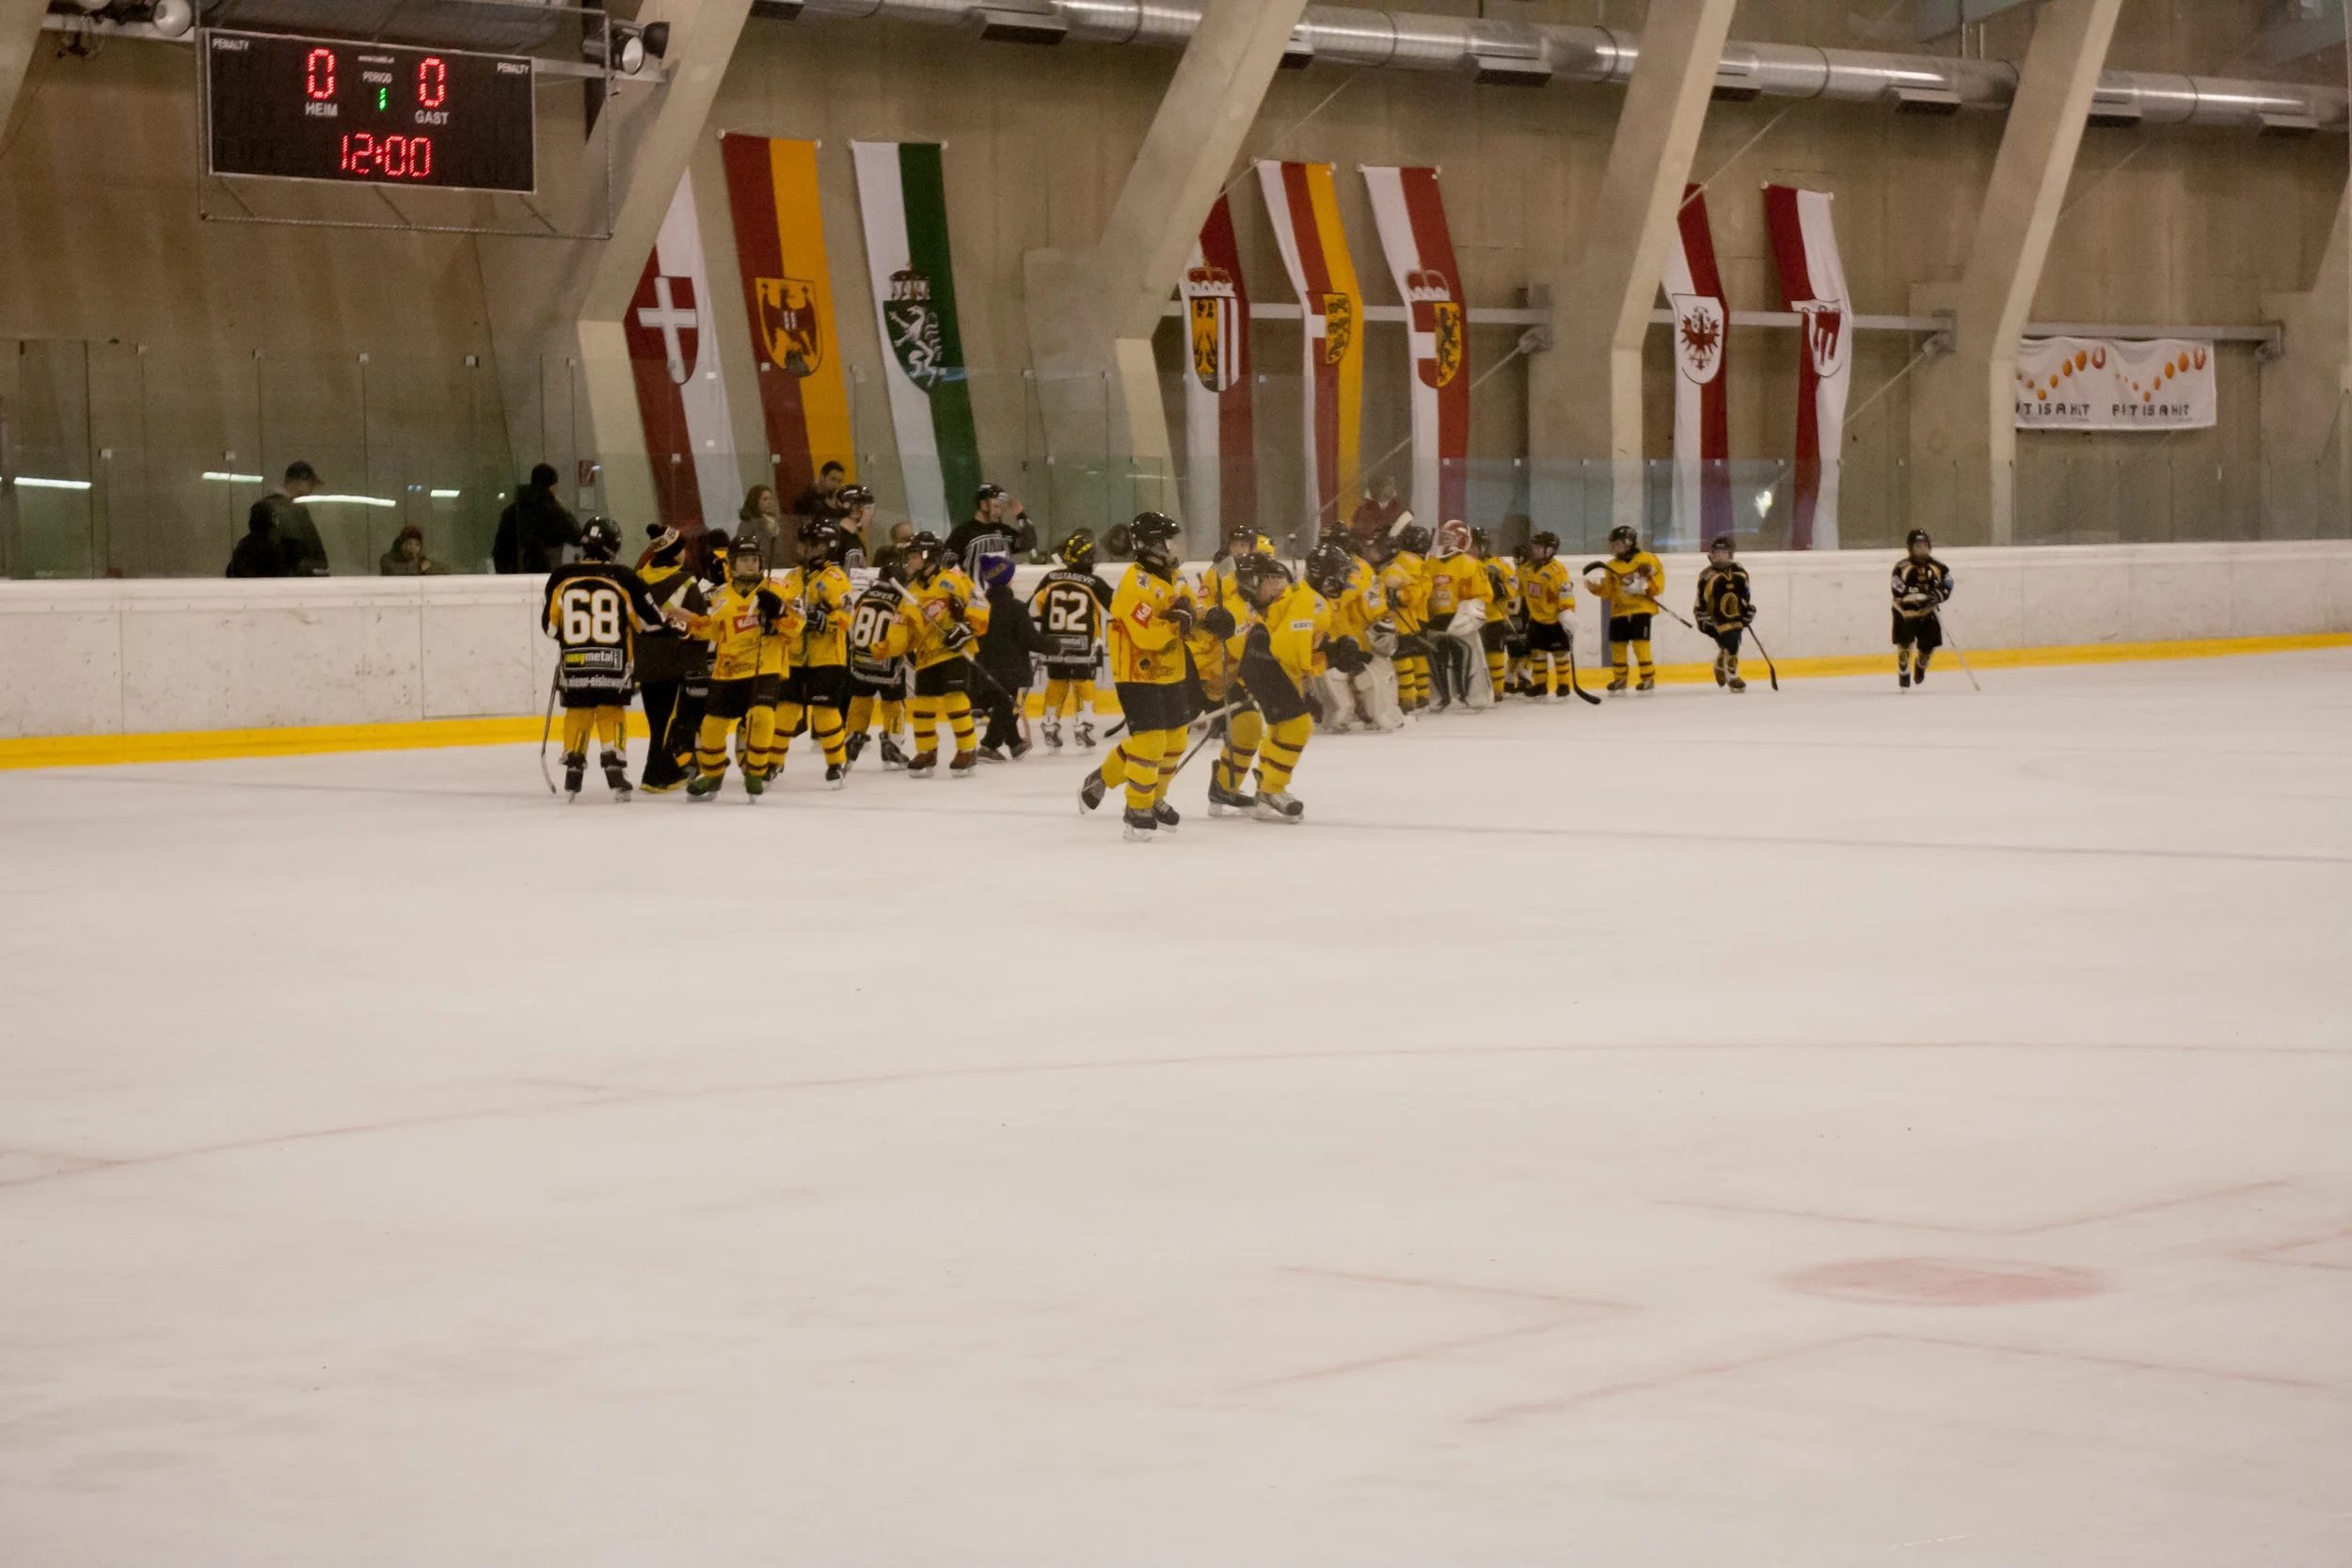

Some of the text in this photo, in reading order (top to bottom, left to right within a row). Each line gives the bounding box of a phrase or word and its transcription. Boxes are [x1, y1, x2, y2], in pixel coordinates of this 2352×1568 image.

[212, 38, 249, 51] PENALTY
[308, 49, 335, 99] 0
[362, 71, 393, 84] PERIOD
[497, 62, 530, 74] PENALTY
[419, 57, 446, 107] 0
[378, 87, 388, 111] 1
[305, 102, 339, 117] HEIM
[415, 109, 450, 125] GAST
[342, 133, 432, 177] 12:00
[2056, 403, 2066, 415] A
[2112, 404, 2137, 417] FIT
[564, 588, 621, 644] 68
[1049, 590, 1089, 631] 62
[854, 606, 895, 647] 80
